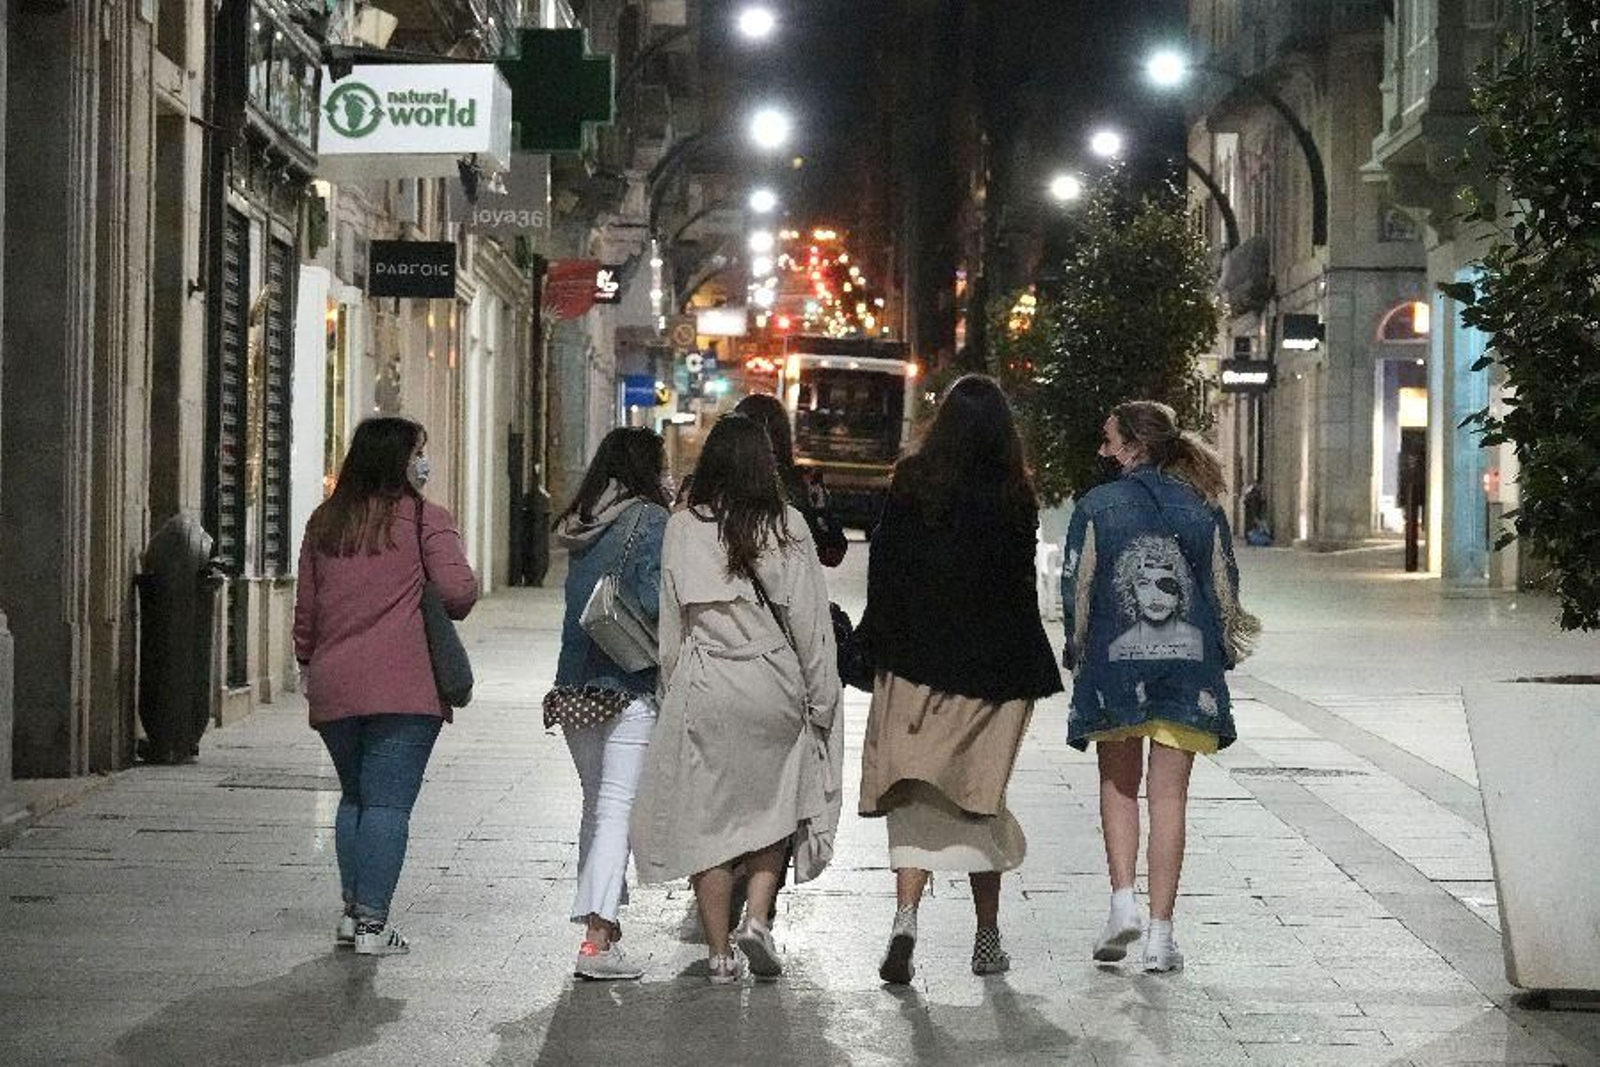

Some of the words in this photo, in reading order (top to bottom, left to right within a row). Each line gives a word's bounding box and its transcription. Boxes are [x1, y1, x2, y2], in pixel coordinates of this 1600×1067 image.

[387, 88, 447, 104] natural
[387, 98, 476, 127] world
[470, 207, 544, 228] joya36
